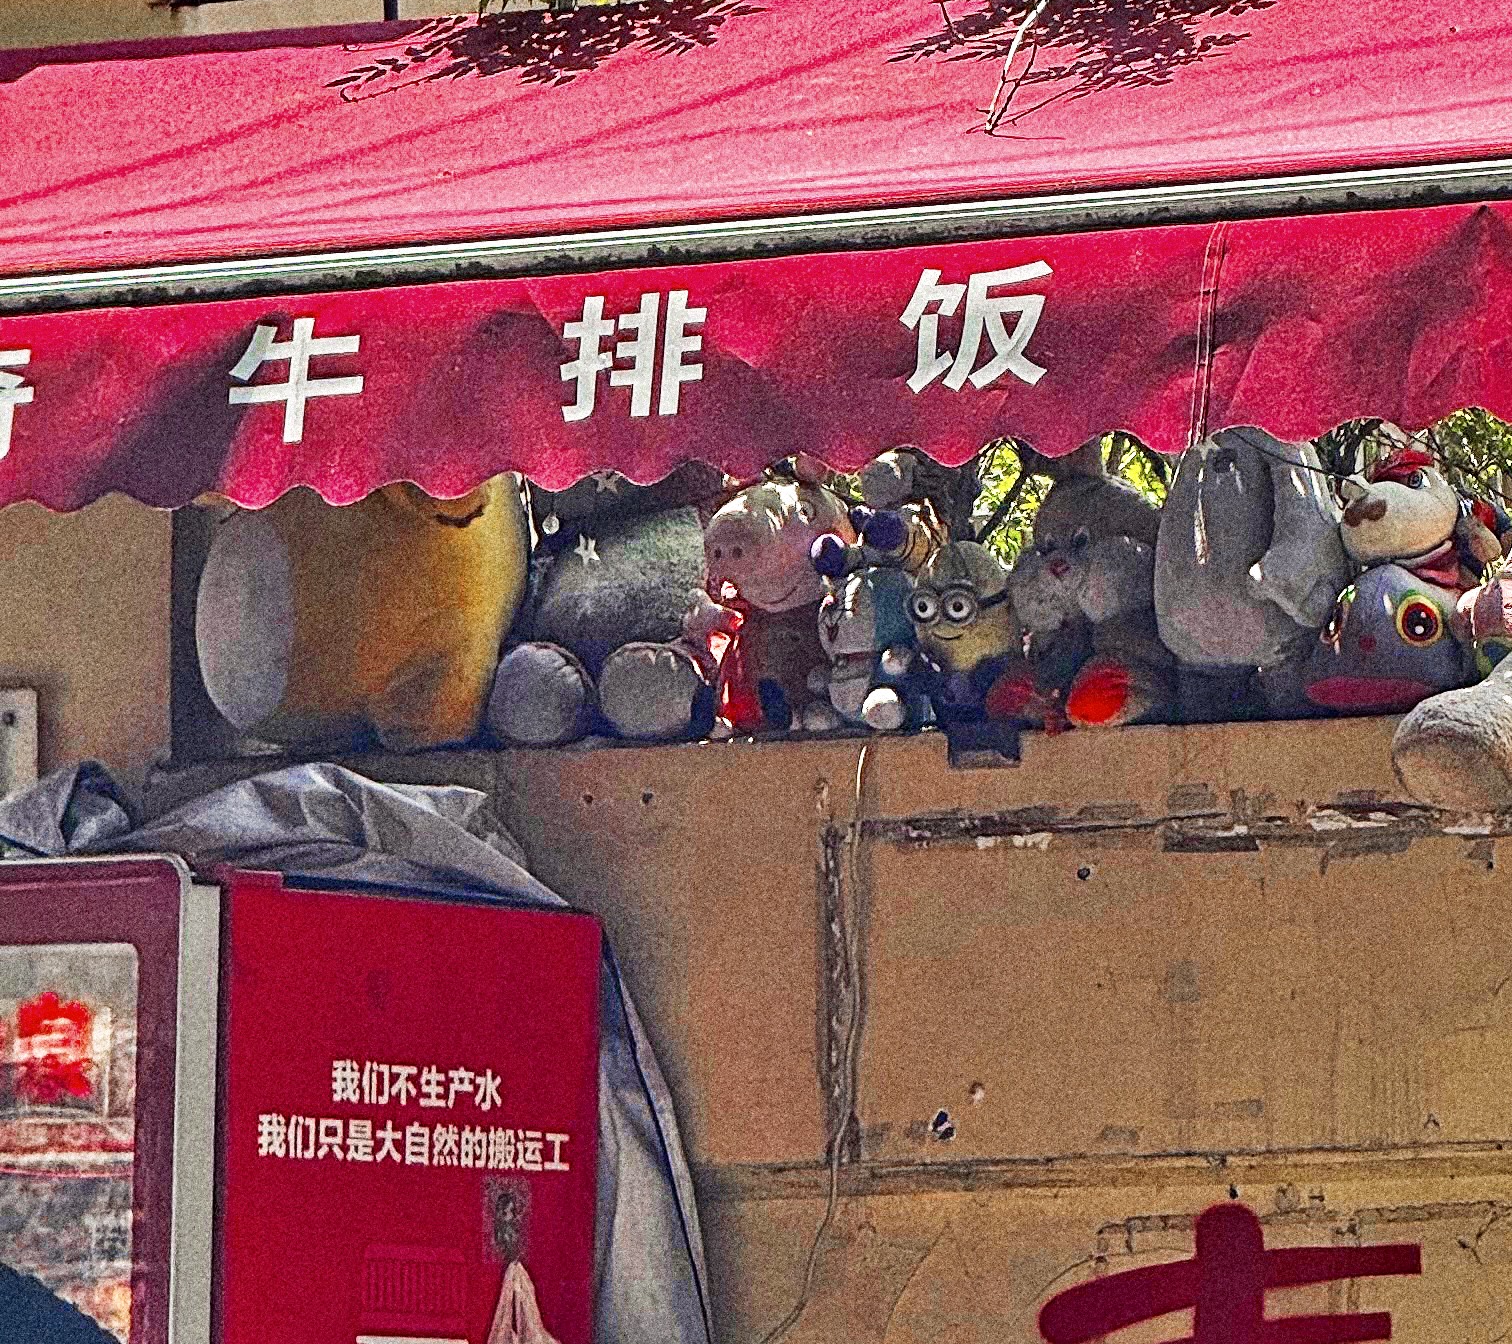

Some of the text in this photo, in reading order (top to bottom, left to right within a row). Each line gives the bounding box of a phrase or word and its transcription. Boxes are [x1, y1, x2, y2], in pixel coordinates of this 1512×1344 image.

[331, 1059, 502, 1111] 我们不生产水
[257, 1113, 570, 1172] 我们只是大自然的搬运工
